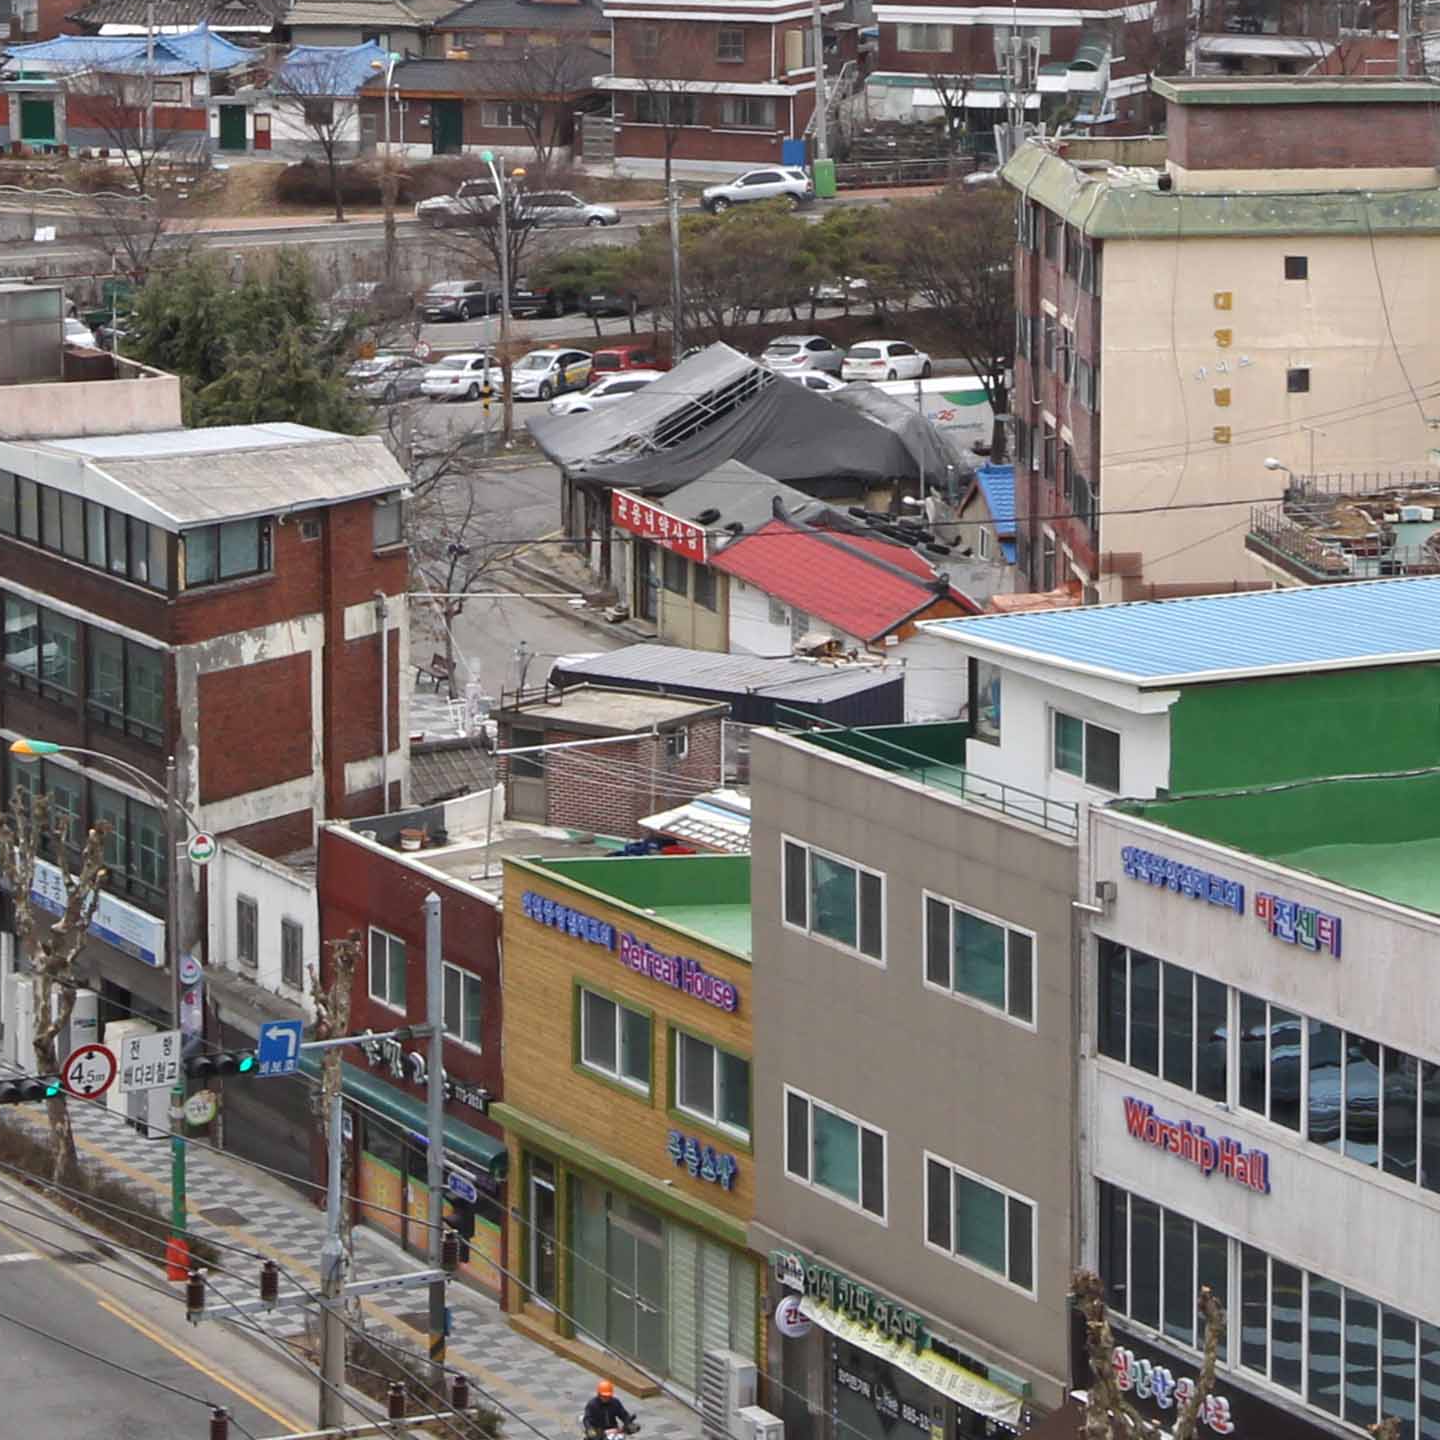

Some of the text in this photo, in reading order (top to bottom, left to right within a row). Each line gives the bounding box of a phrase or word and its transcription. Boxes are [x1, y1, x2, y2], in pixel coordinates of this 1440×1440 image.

[1255, 891, 1342, 959] 비전센터
[619, 931, 738, 1013] Retreat House
[70, 1062, 105, 1084] 4.5m
[1123, 1096, 1271, 1194] Worship Hall
